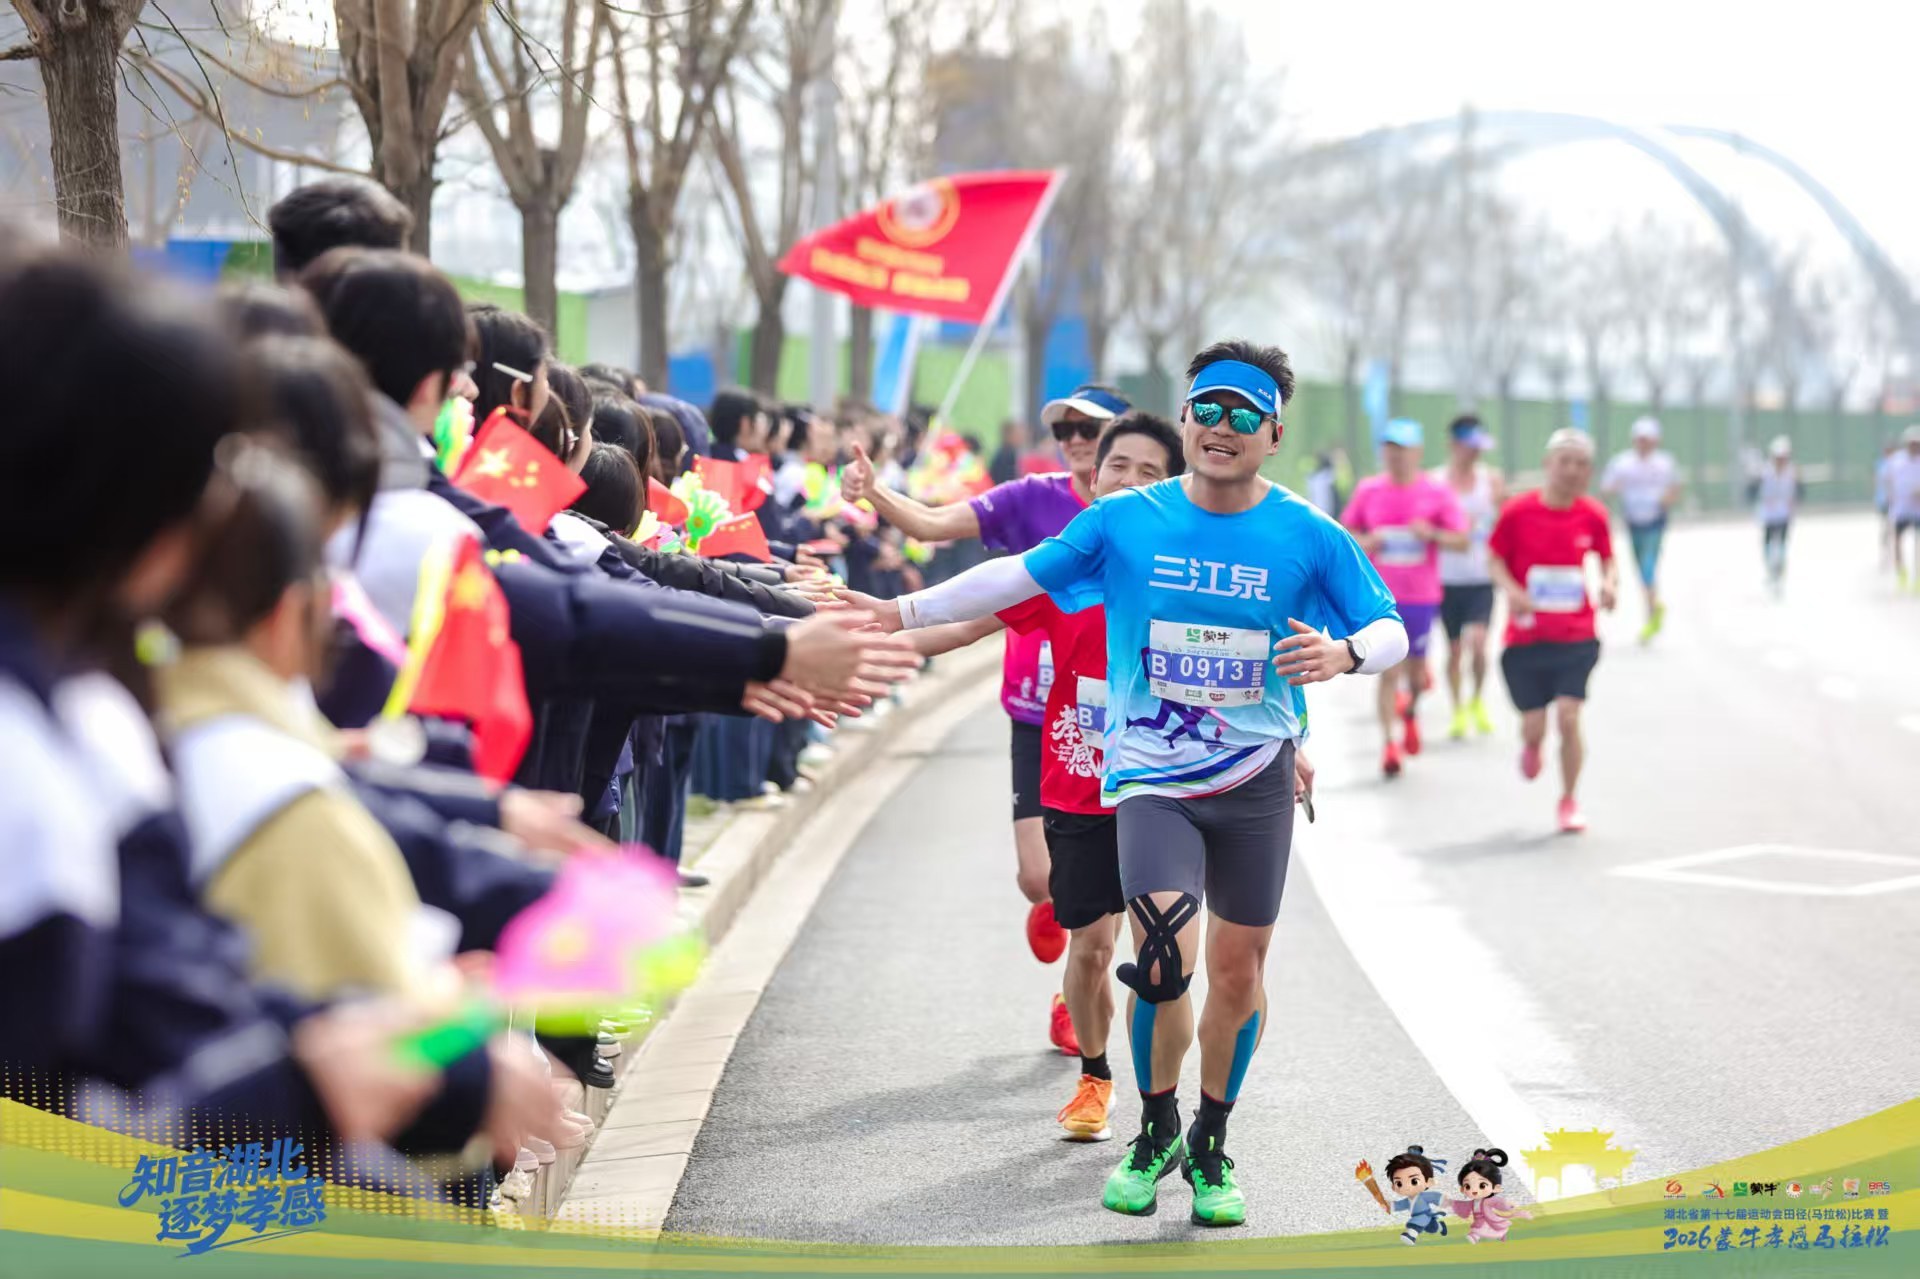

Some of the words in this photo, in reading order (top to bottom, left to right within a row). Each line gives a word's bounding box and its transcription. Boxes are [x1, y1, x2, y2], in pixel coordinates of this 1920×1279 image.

[1149, 554, 1271, 601] 三江泉
[1203, 630, 1230, 644] 蒙牛
[1151, 653, 1168, 676] B
[1180, 656, 1244, 680] 0913
[1041, 670, 1054, 685] B
[1078, 707, 1093, 727] B
